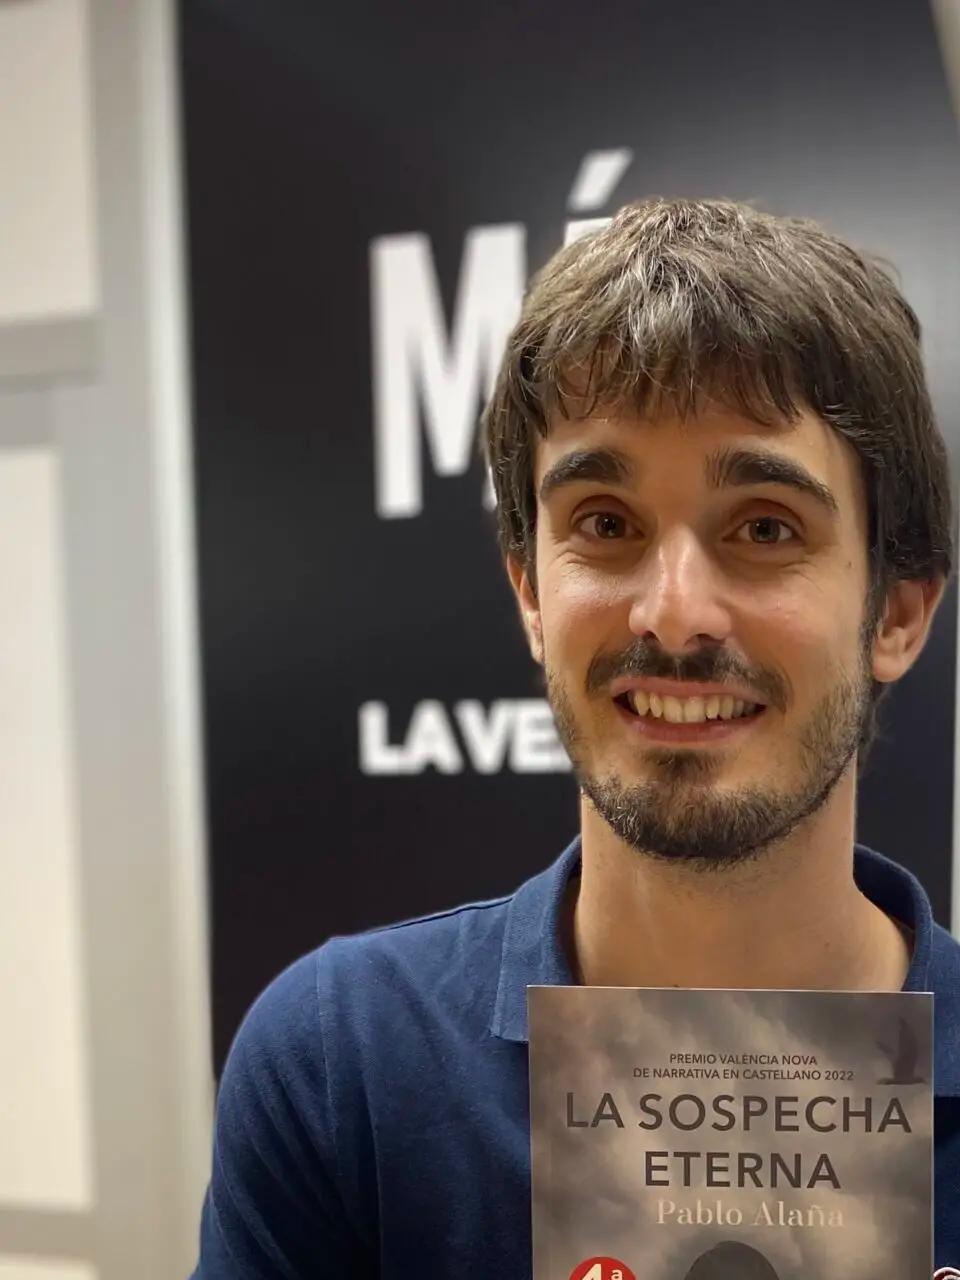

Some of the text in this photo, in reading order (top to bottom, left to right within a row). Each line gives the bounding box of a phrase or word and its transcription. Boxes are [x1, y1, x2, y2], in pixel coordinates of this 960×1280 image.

[358, 698, 574, 775] LA VE
[632, 1067, 854, 1081] DE NARRATIVA EN CASTELLANO 2022
[669, 1053, 717, 1065] PREMIO
[782, 1054, 818, 1066] NOVA
[566, 1091, 913, 1134] LA SOSPECHA
[644, 1151, 842, 1190] ETERNA
[655, 1199, 845, 1228] Pablo Alaña
